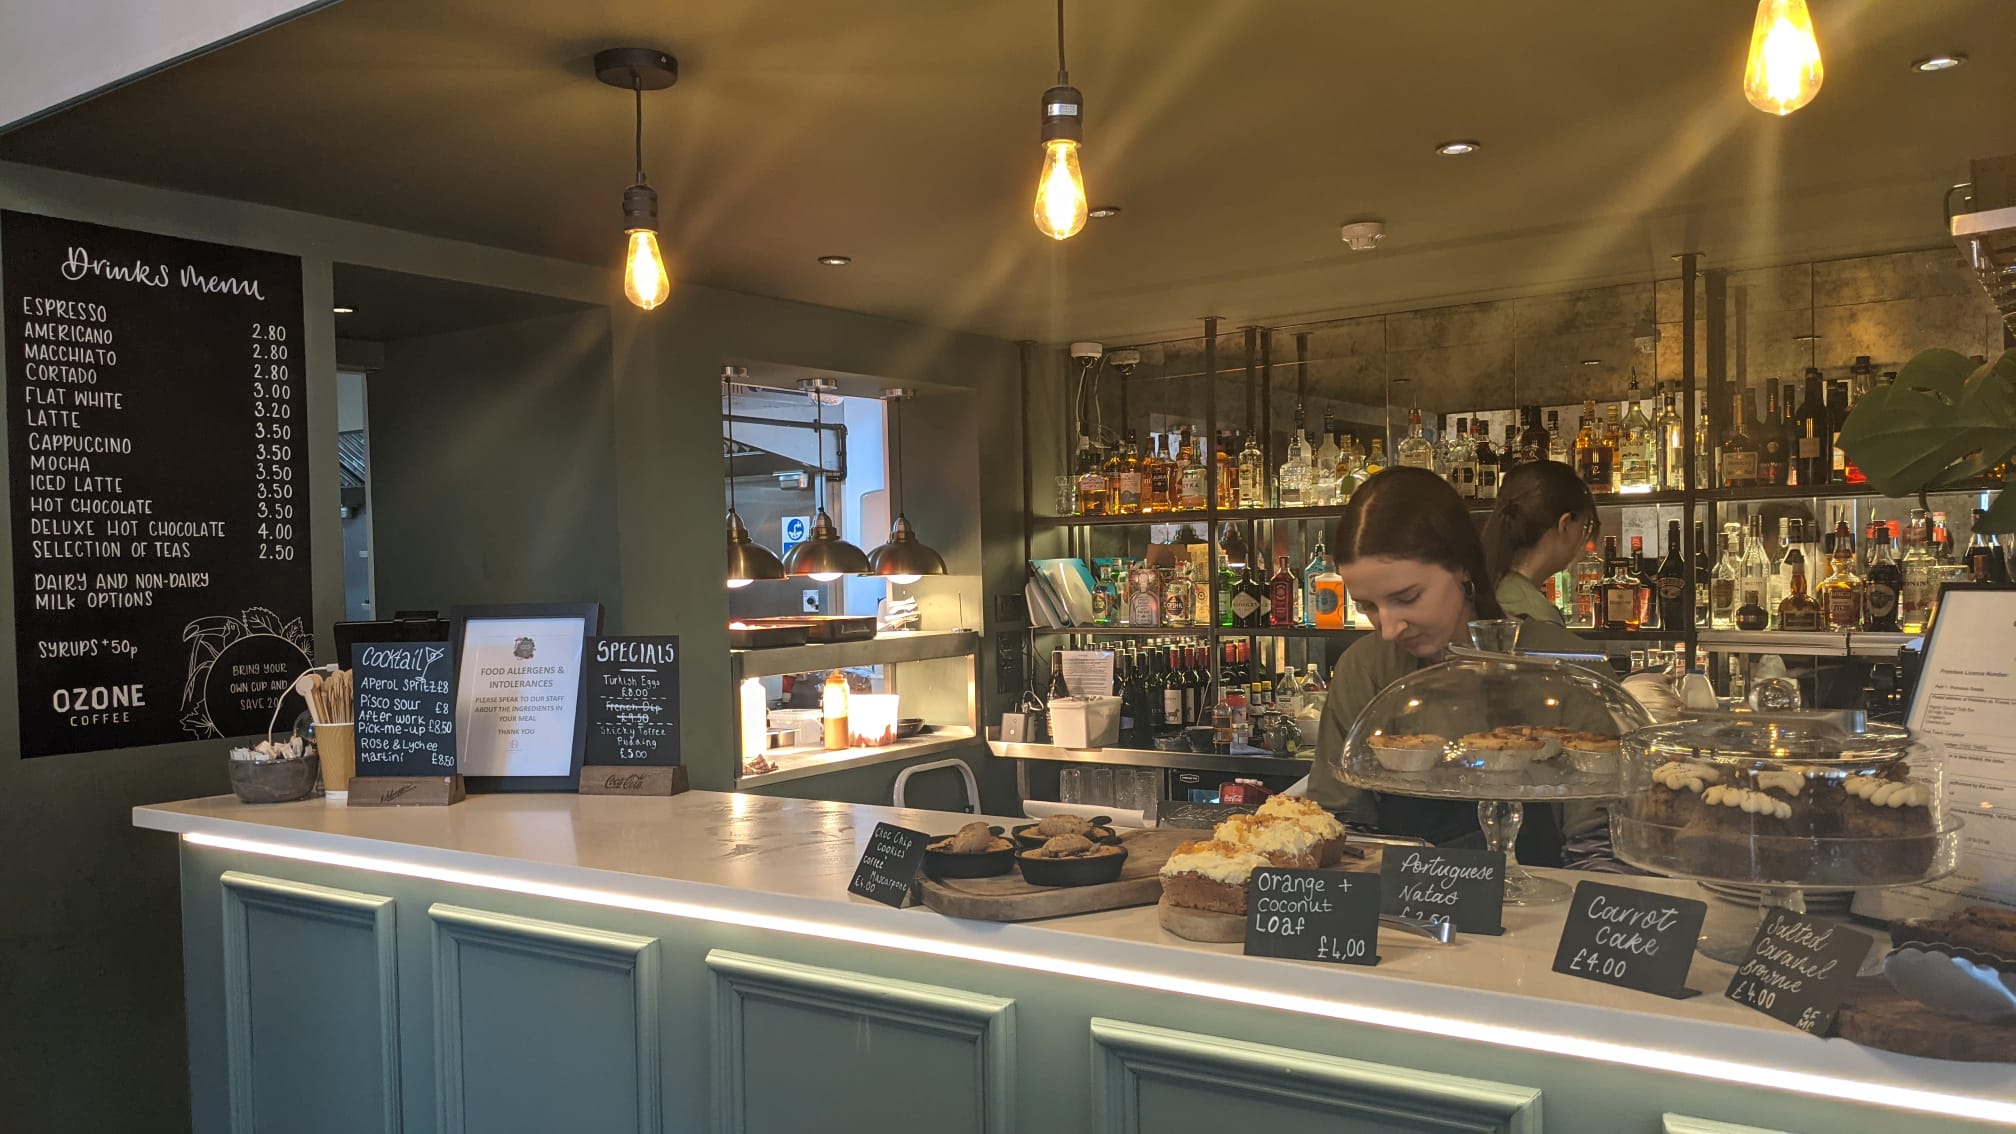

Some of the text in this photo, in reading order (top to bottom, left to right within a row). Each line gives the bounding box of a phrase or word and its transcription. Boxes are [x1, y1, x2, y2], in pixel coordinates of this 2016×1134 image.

[62, 247, 168, 287] Drinks
[23, 297, 107, 322] ESPRESSO
[24, 322, 113, 344] AMERICANO
[252, 323, 286, 341] 2.80
[25, 343, 117, 366] MACCHIATO
[253, 344, 288, 360] 2.80
[26, 363, 97, 384] CORTADO
[254, 364, 289, 380] 2.80
[26, 386, 123, 410] FLAT WHITE
[253, 382, 291, 399] 3.00
[27, 409, 81, 428] LATTE
[254, 402, 290, 419] 3.20
[255, 422, 291, 440] 3.50
[29, 432, 132, 454] CAPPUCCINO
[256, 444, 291, 461] 3.50
[30, 455, 90, 473] MOCHA
[256, 463, 292, 481] 3.50
[30, 475, 123, 493] ICED LATTE
[257, 484, 293, 499] 3.50
[30, 497, 153, 515] HOT CHOCOLATE
[257, 502, 293, 520] 3.50
[31, 519, 226, 538] DELUXE HOT CHOCOLATE
[257, 523, 292, 540] 4.00
[33, 541, 191, 559] SELECTION OF TEAS
[259, 543, 294, 561] 2.50
[34, 572, 209, 591] DAIRY AND NON-DAIRY
[36, 591, 153, 610] MILK OPTIONS
[38, 638, 98, 659] SYRUPS
[596, 641, 674, 665] SPECIALS
[362, 646, 423, 671] Cocktail
[232, 662, 288, 677] BRING YOUR
[481, 666, 565, 676] FOOD ALLERGENS &
[230, 680, 288, 694] OWN CUP AND
[489, 680, 553, 689] INTOLERANCES
[603, 674, 638, 686] Turkish
[53, 684, 146, 713] OZONE
[621, 688, 648, 697] £8.00
[240, 697, 264, 710] SAVE
[360, 694, 390, 709] Pisco
[435, 702, 449, 715] £8
[70, 712, 130, 727] COFFEE
[359, 710, 426, 724] After work
[358, 722, 426, 736] Pick-me-up
[393, 739, 400, 750] &
[403, 739, 438, 752] Lychee
[620, 749, 648, 759] £5.00
[362, 751, 404, 762] Martini
[1400, 852, 1495, 889] Portuguese
[1258, 872, 1353, 901] Orange +
[1587, 895, 1679, 931] Carrot
[1256, 914, 1305, 936] Loaf
[1766, 915, 1834, 952] Salted
[1595, 926, 1660, 956] Cake
[1570, 948, 1626, 978] £4.00
[1731, 980, 1776, 1009] £4.00
